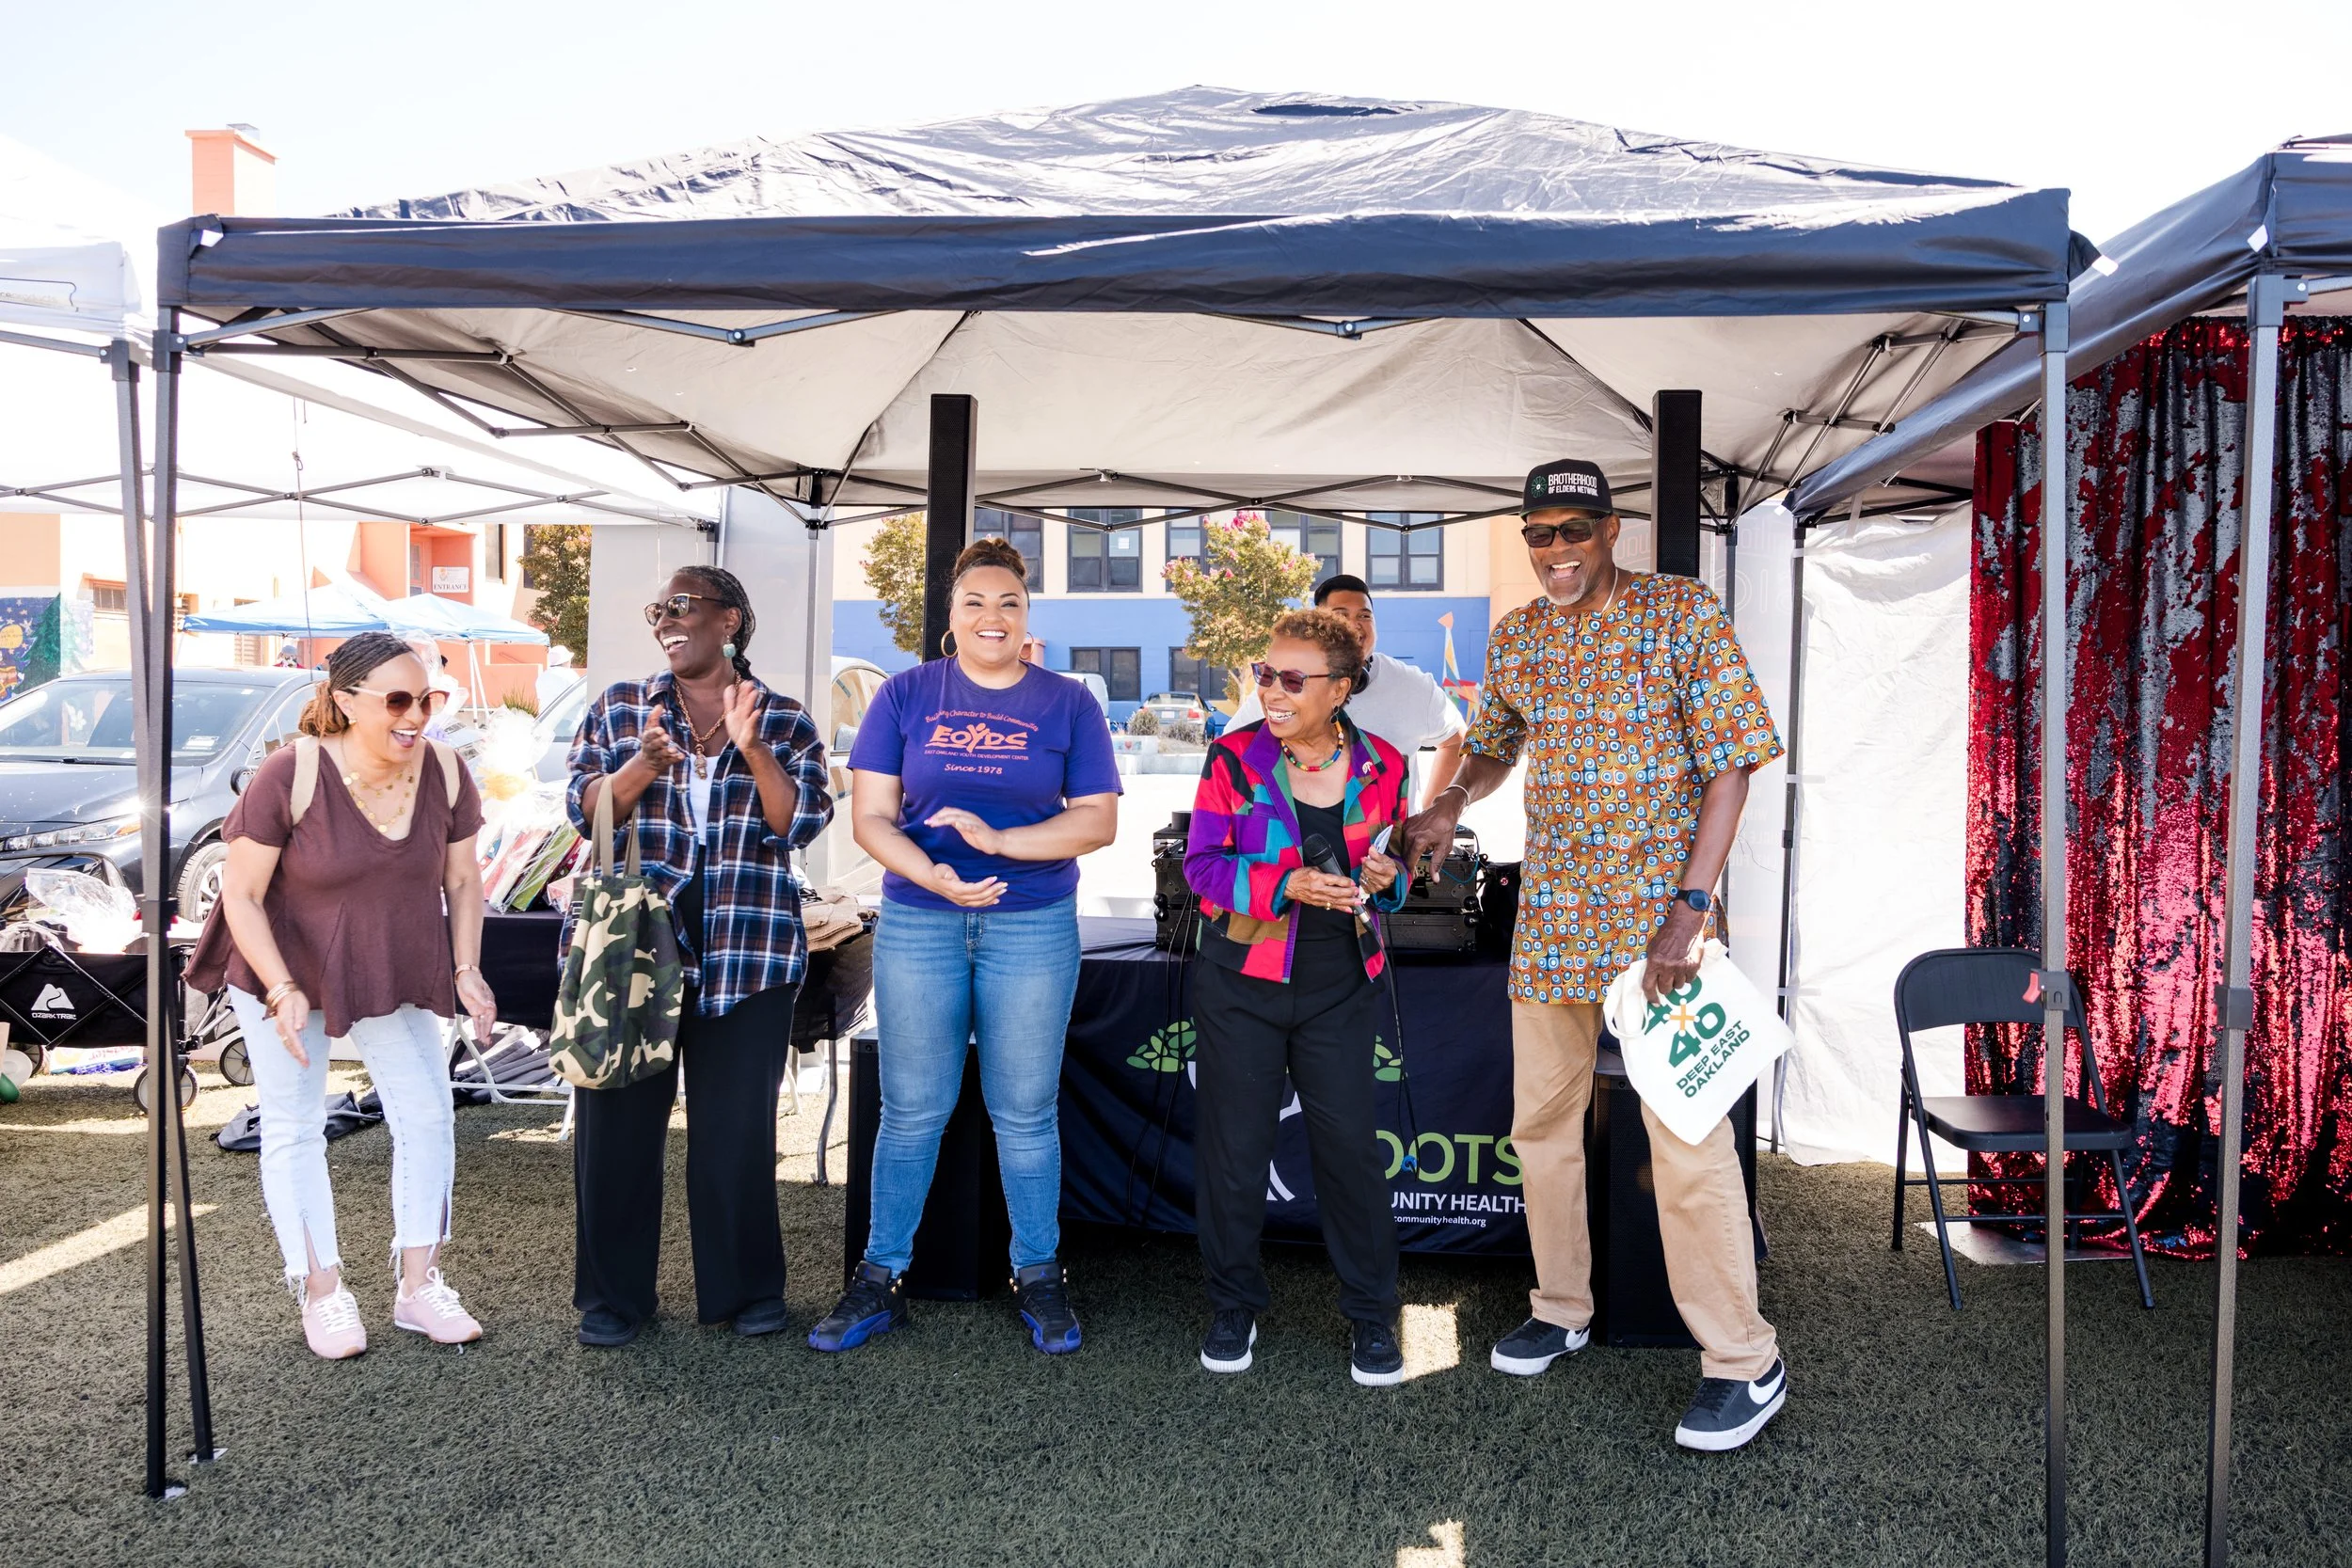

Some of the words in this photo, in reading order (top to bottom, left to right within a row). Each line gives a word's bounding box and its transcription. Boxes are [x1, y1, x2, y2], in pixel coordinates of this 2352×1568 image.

[1548, 473, 1597, 488] BROTHERHOOD
[1548, 485, 1555, 494] OF
[1556, 484, 1577, 493] ELDERS
[944, 763, 976, 772] Since
[977, 766, 1003, 774] 1978
[1668, 1002, 1726, 1069] 40
[1677, 1055, 1709, 1089] DEEP
[1710, 1021, 1741, 1055] EAST
[1684, 1029, 1750, 1098] OAKLAND
